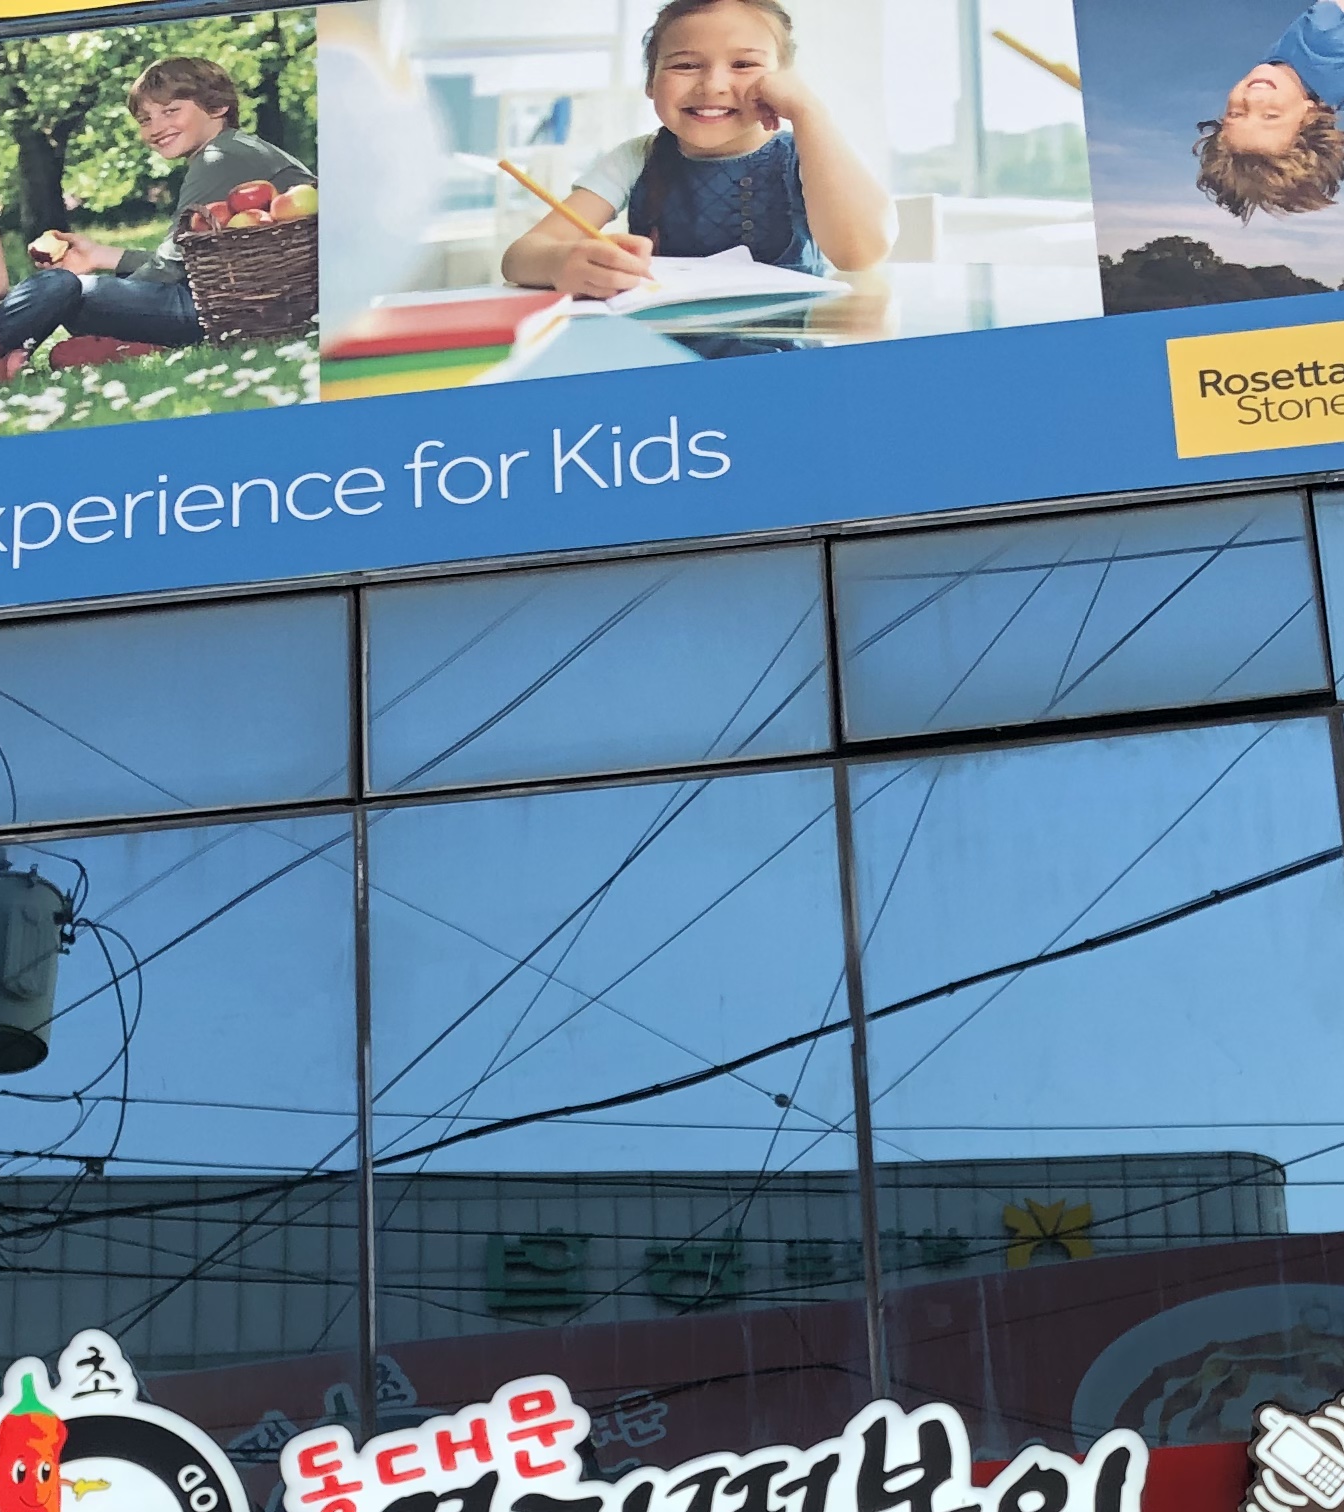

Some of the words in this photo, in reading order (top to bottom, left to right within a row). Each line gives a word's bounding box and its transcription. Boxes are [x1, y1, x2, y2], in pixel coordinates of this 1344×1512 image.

[403, 439, 530, 509] for
[550, 415, 731, 495] Kids
[72, 1346, 123, 1400] 초
